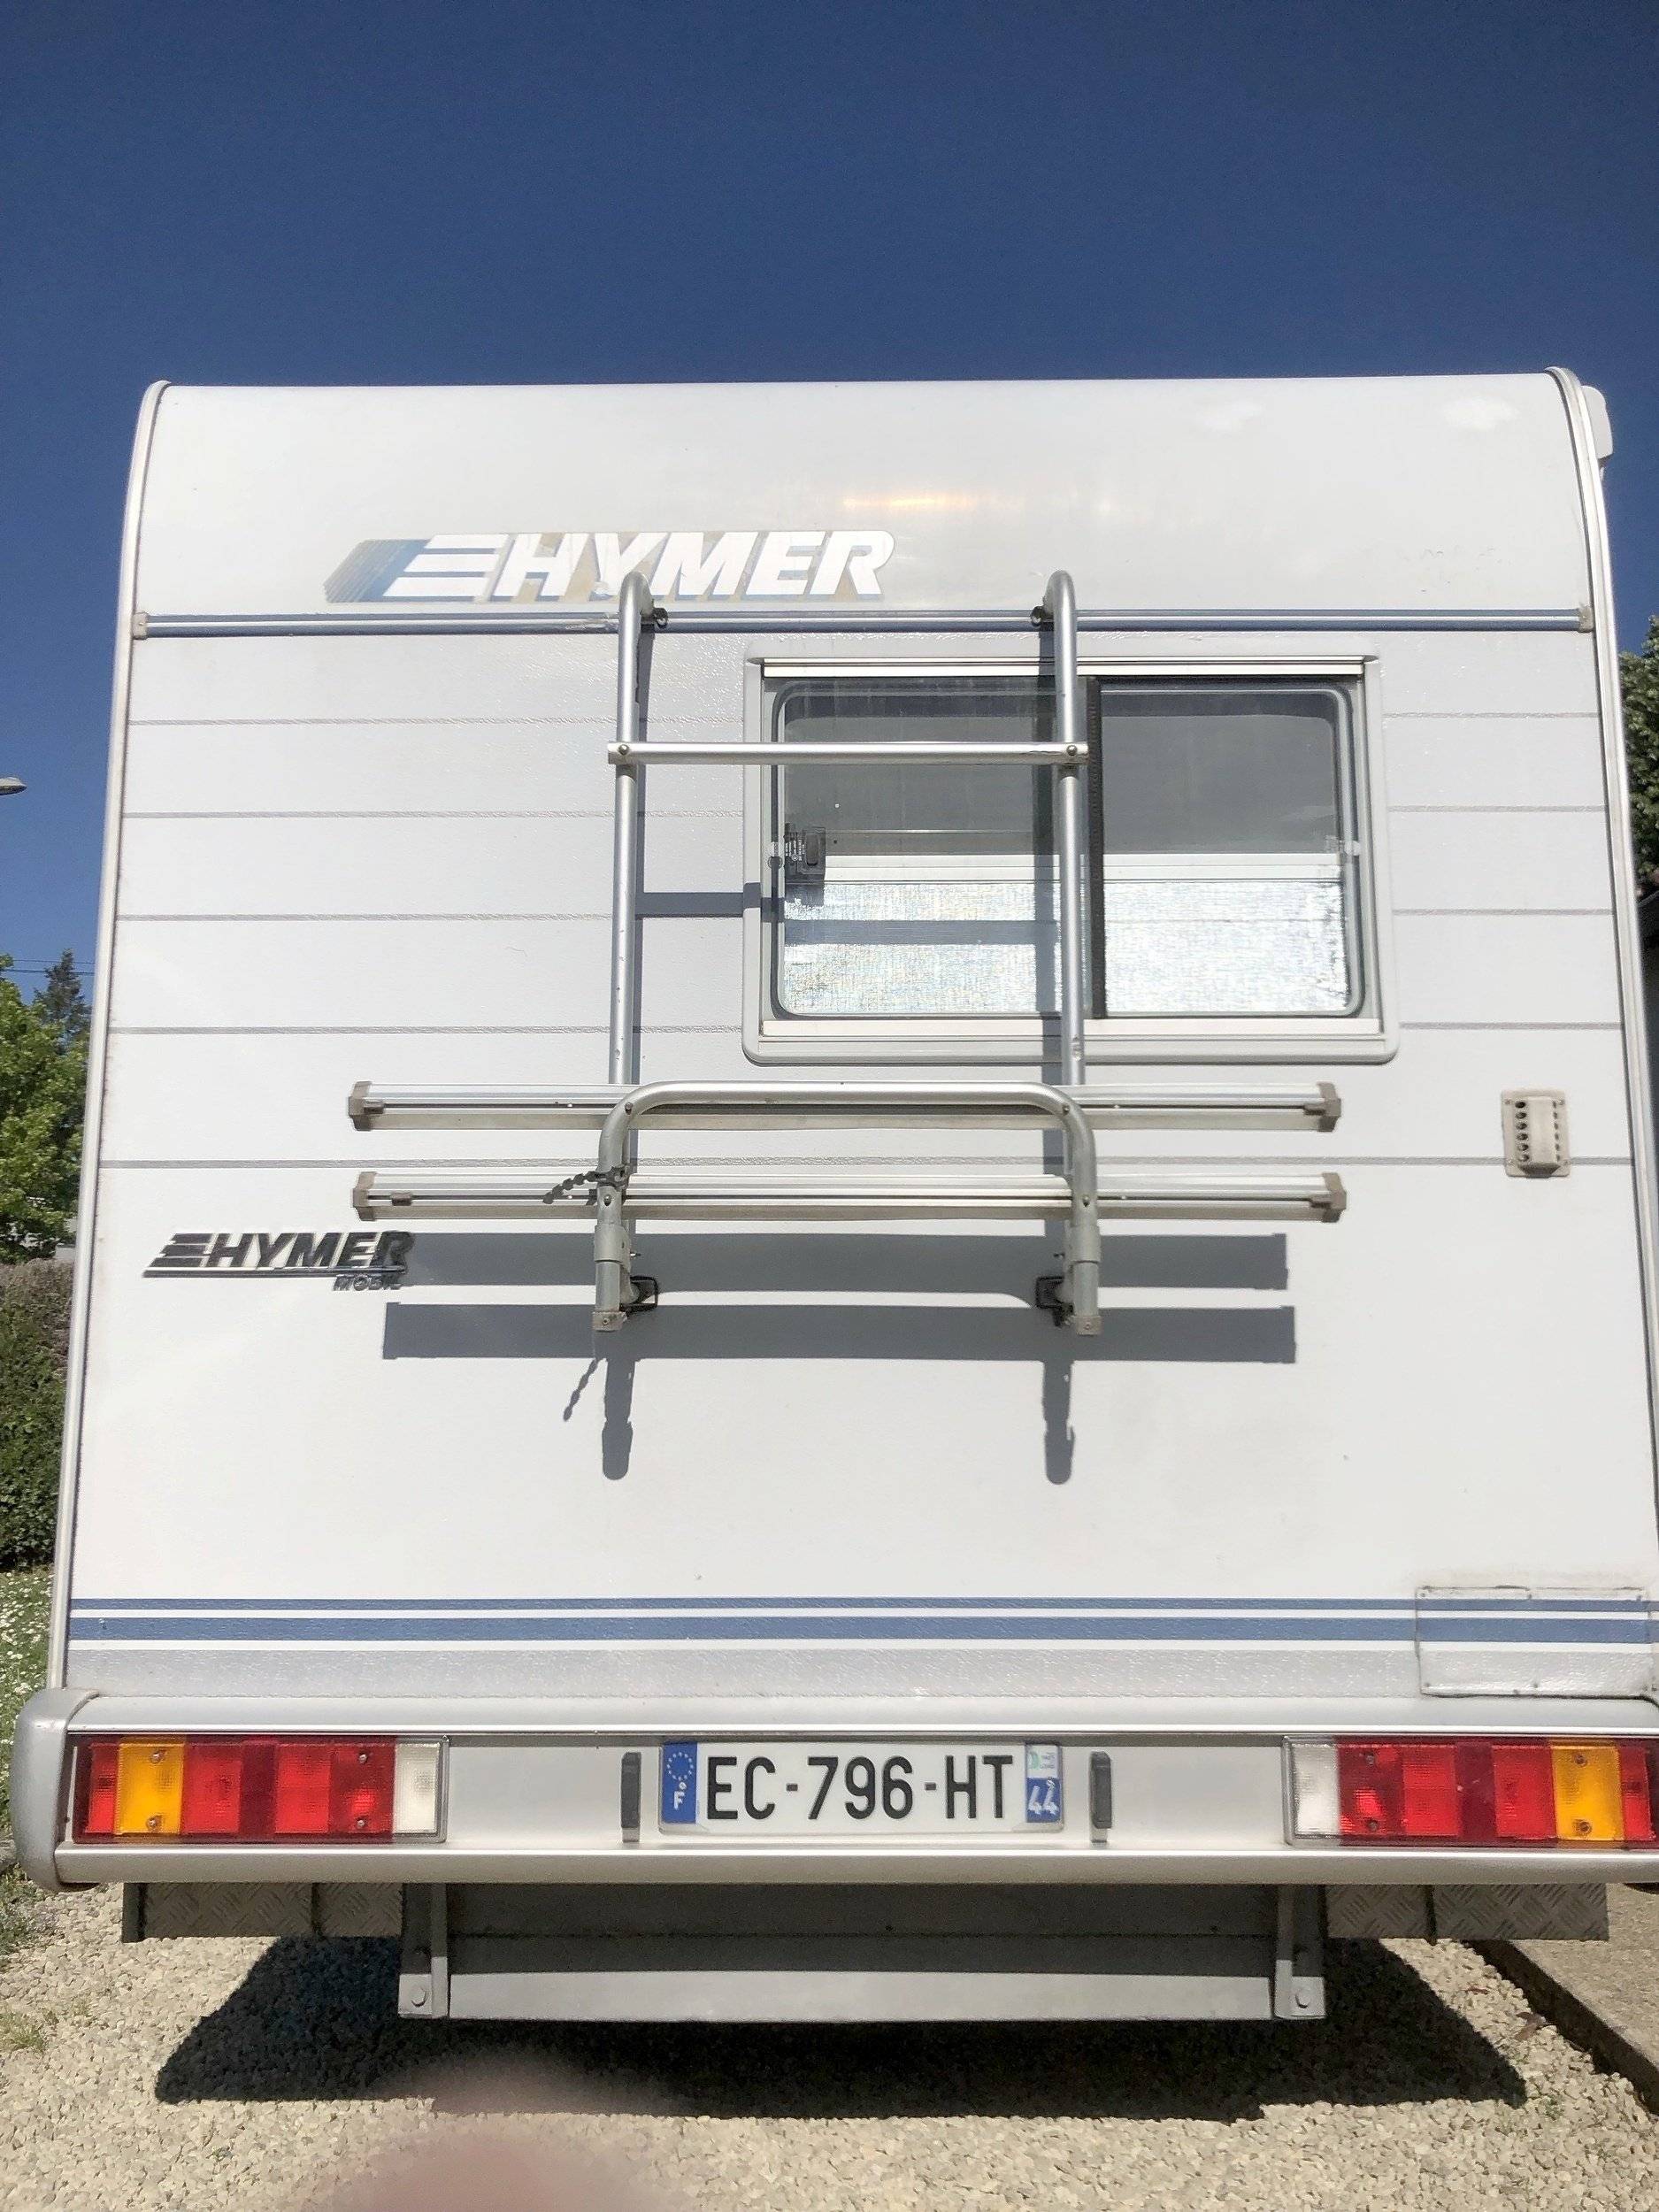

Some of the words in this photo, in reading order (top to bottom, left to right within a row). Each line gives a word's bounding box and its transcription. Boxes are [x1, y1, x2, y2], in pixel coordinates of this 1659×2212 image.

[491, 530, 895, 597] HYMER
[205, 1231, 416, 1269] HYMER
[673, 1790, 686, 1810] F
[706, 1755, 1014, 1821] EC-796-HT
[1027, 1779, 1058, 1816] 44
